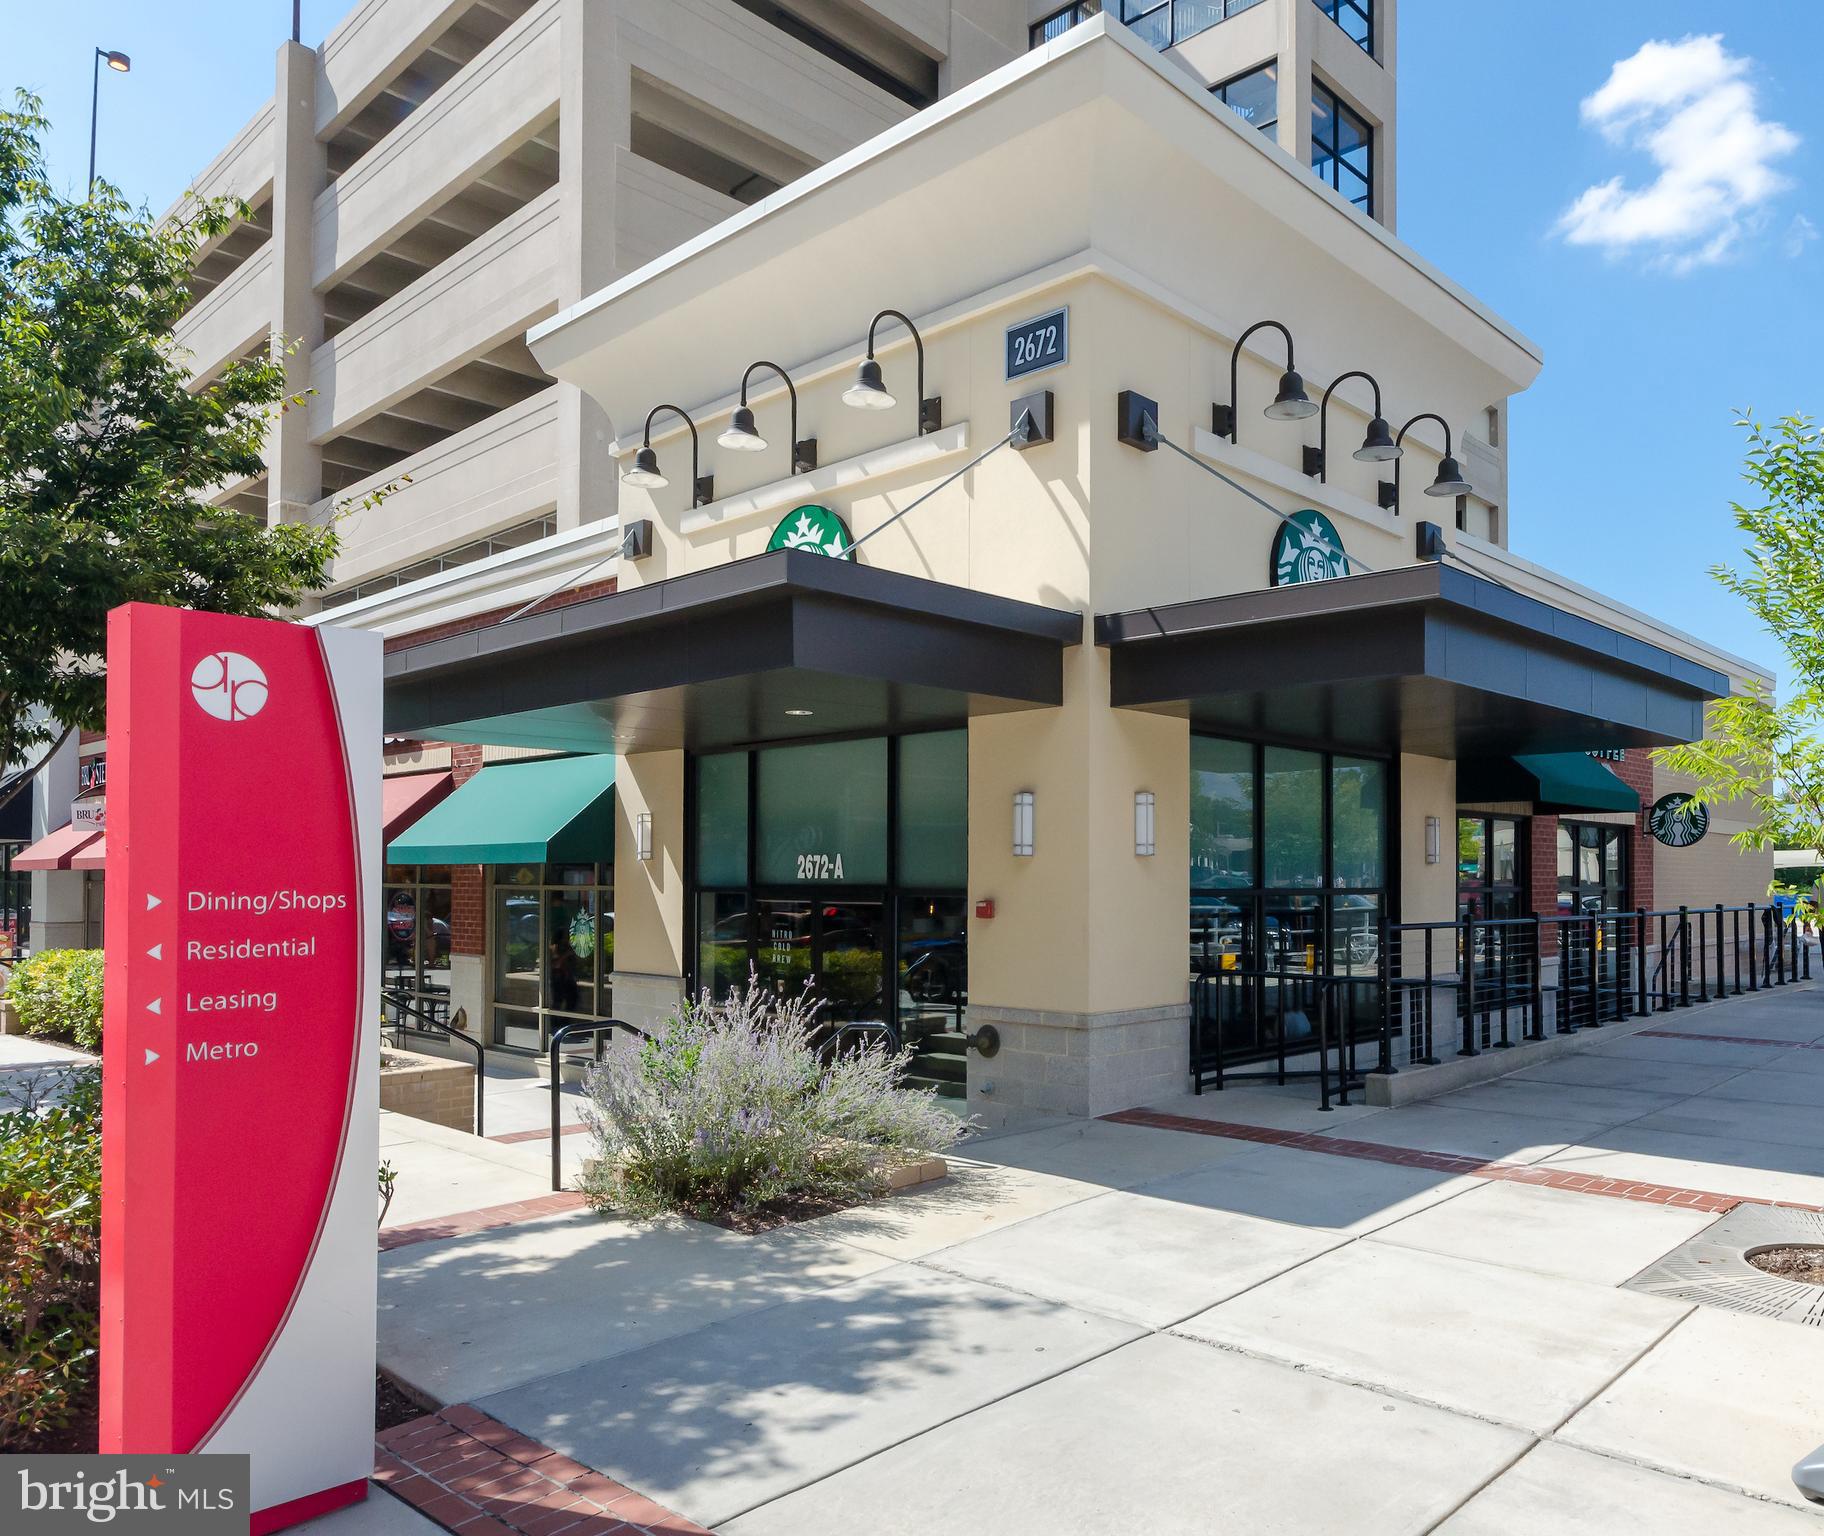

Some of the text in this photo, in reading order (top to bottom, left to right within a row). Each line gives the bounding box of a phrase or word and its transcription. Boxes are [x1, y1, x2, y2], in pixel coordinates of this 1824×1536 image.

[1014, 325, 1057, 366] 2672
[797, 853, 844, 879] 2672-A
[187, 889, 347, 915] Dining/Shops
[771, 929, 793, 940] NITRO
[186, 936, 316, 961] Residential
[773, 941, 791, 952] COLD
[772, 954, 791, 964] BREW
[186, 989, 277, 1012] Leasing
[186, 1041, 259, 1062] Metro
